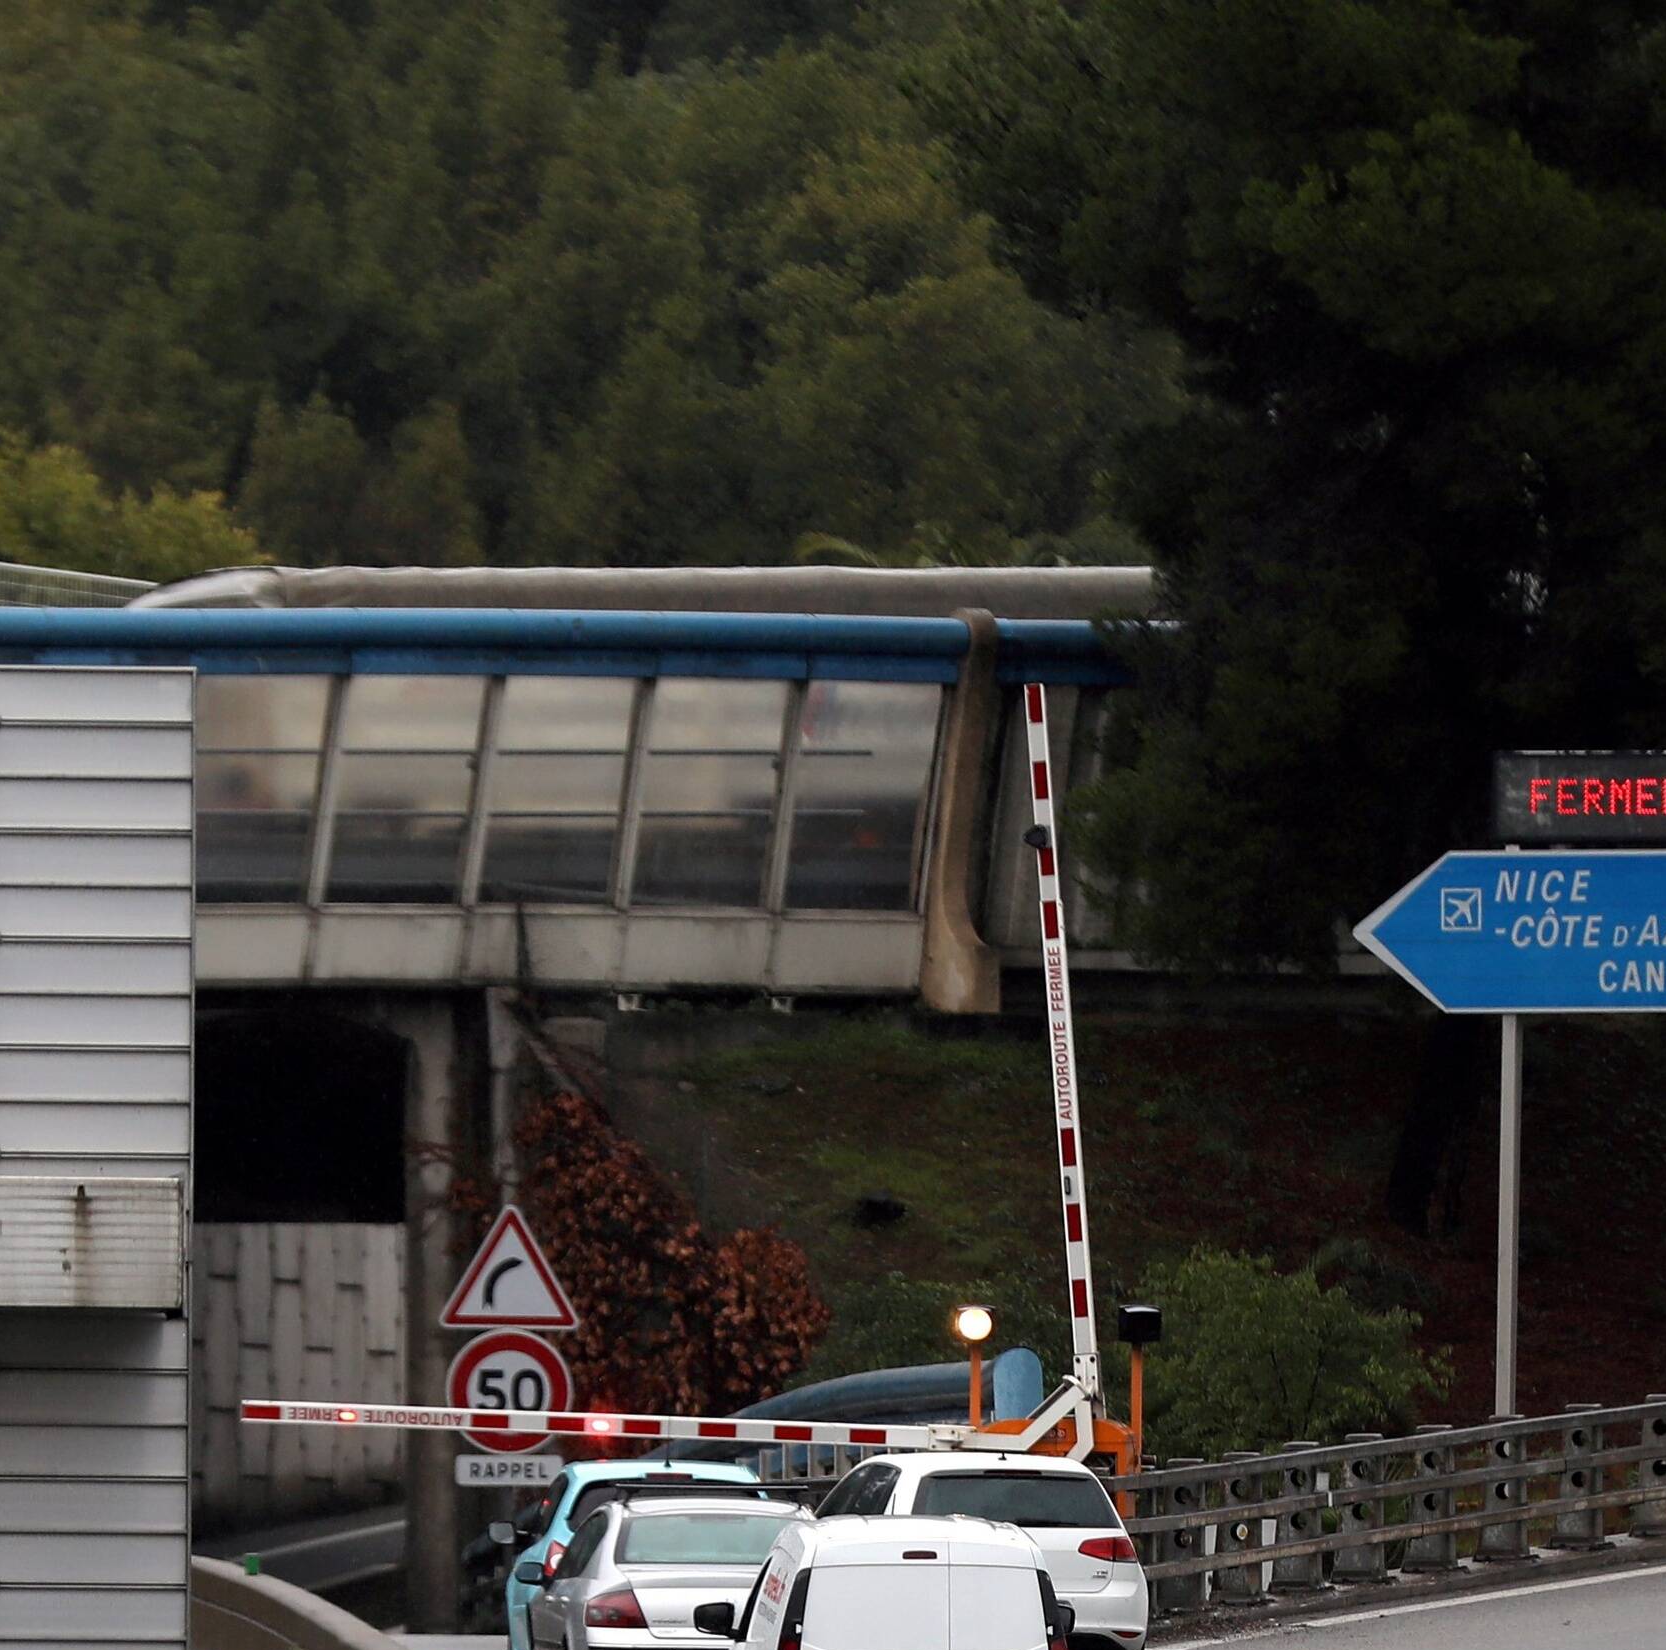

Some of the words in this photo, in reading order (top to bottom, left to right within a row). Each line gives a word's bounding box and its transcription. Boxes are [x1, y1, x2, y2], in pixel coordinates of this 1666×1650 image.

[1495, 870, 1592, 903] NICE
[1047, 946, 1064, 1012] FERMEE
[1052, 1020, 1072, 1122] AUTOROUTE
[475, 1368, 545, 1412] 50
[364, 1409, 462, 1427] AUTOROUTE
[469, 1462, 548, 1479] RAPPEL
